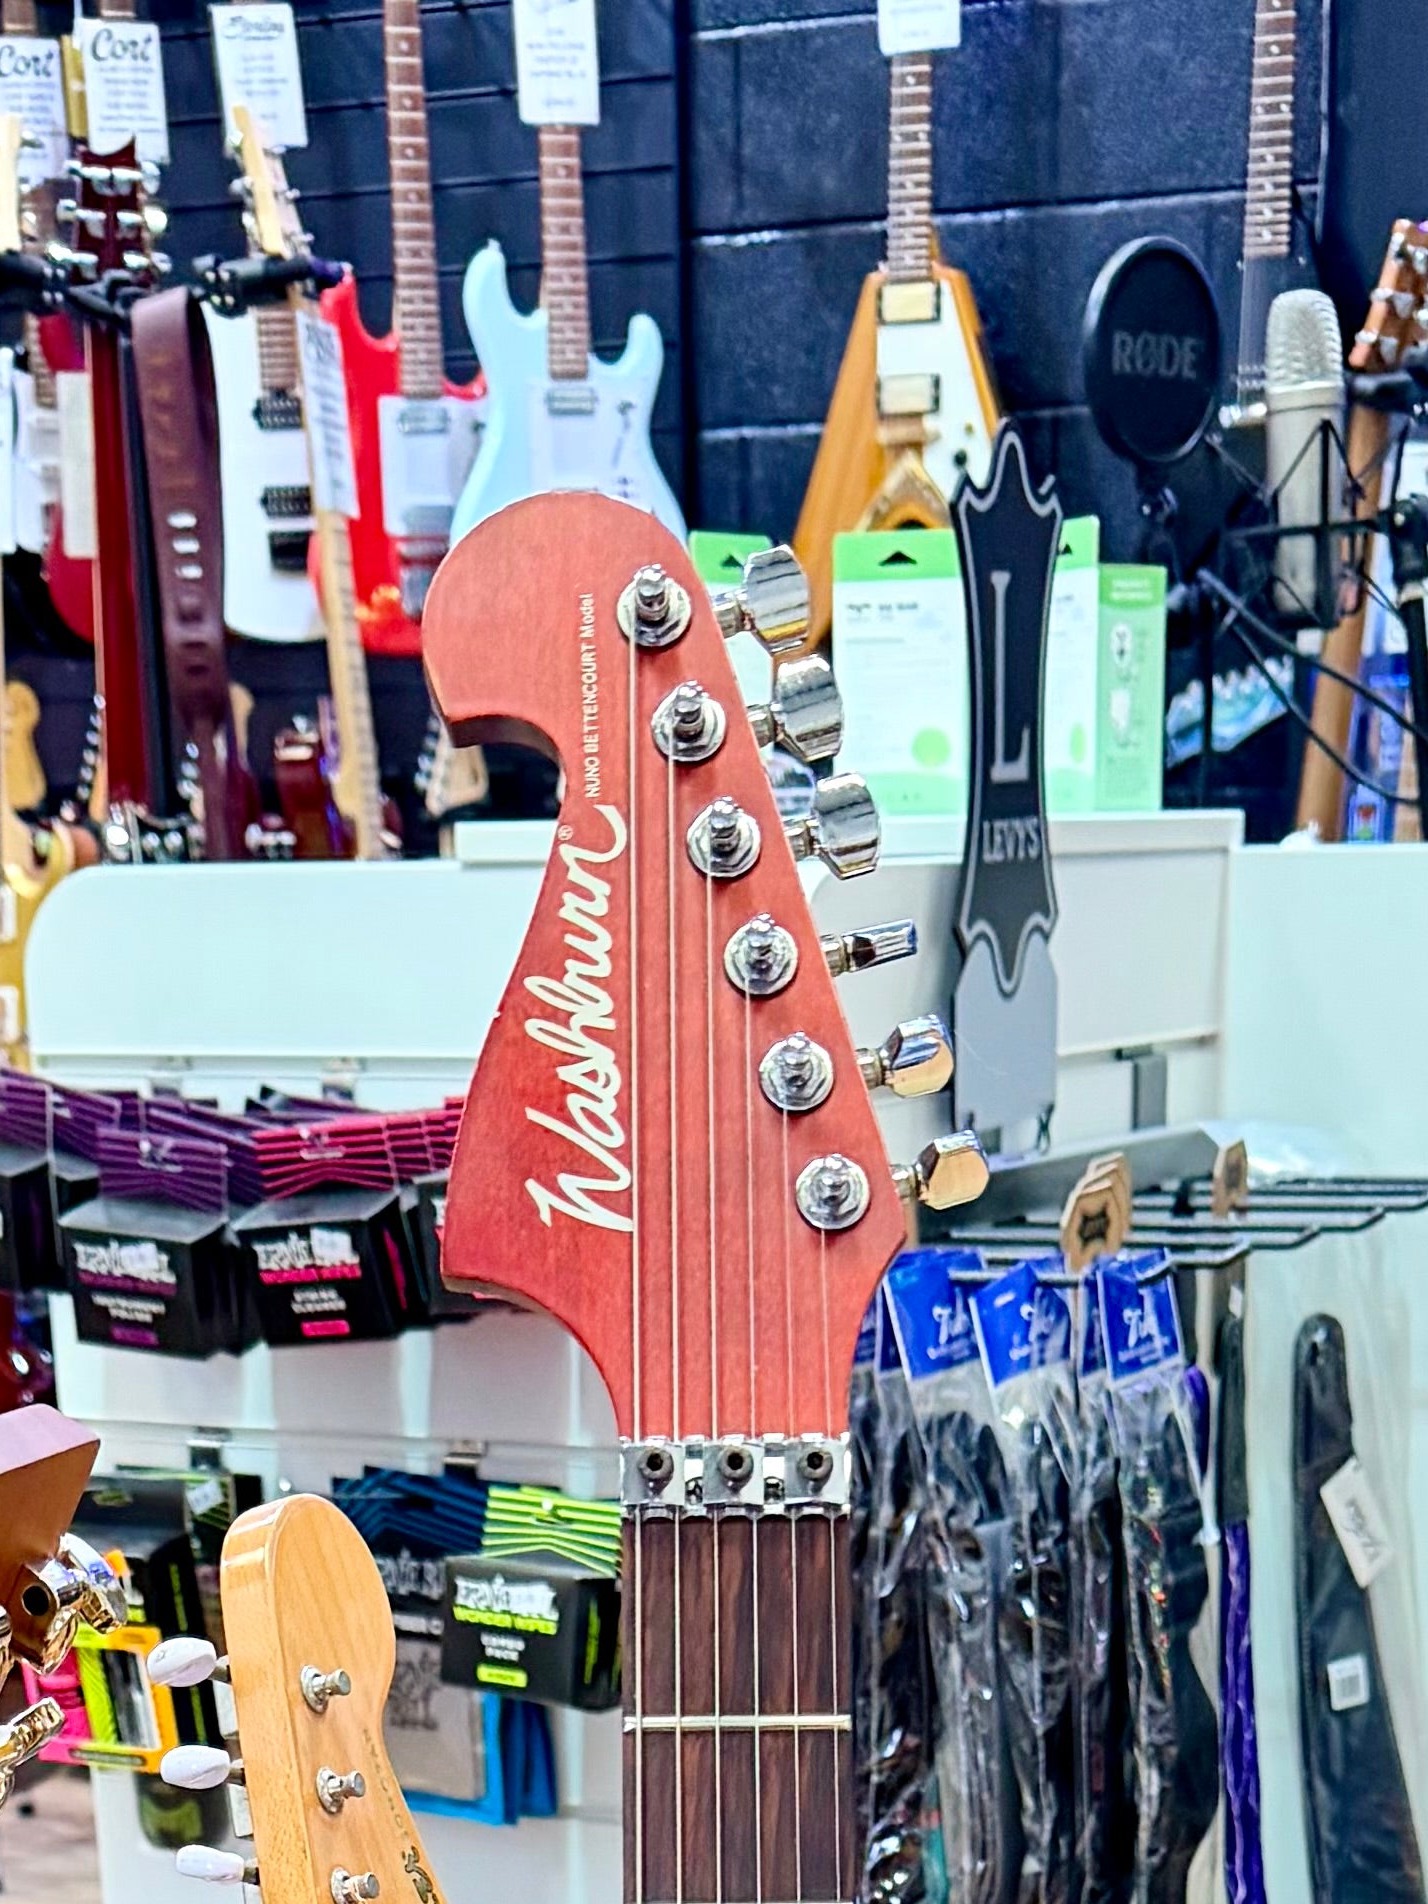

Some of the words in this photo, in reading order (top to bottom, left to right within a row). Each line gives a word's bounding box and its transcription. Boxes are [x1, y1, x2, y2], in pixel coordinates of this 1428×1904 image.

[90, 27, 152, 63] Cort
[579, 593, 595, 639] Model
[581, 642, 600, 754] BETTENCOURT
[585, 757, 601, 798] NUNO
[524, 803, 628, 1232] Washburn
